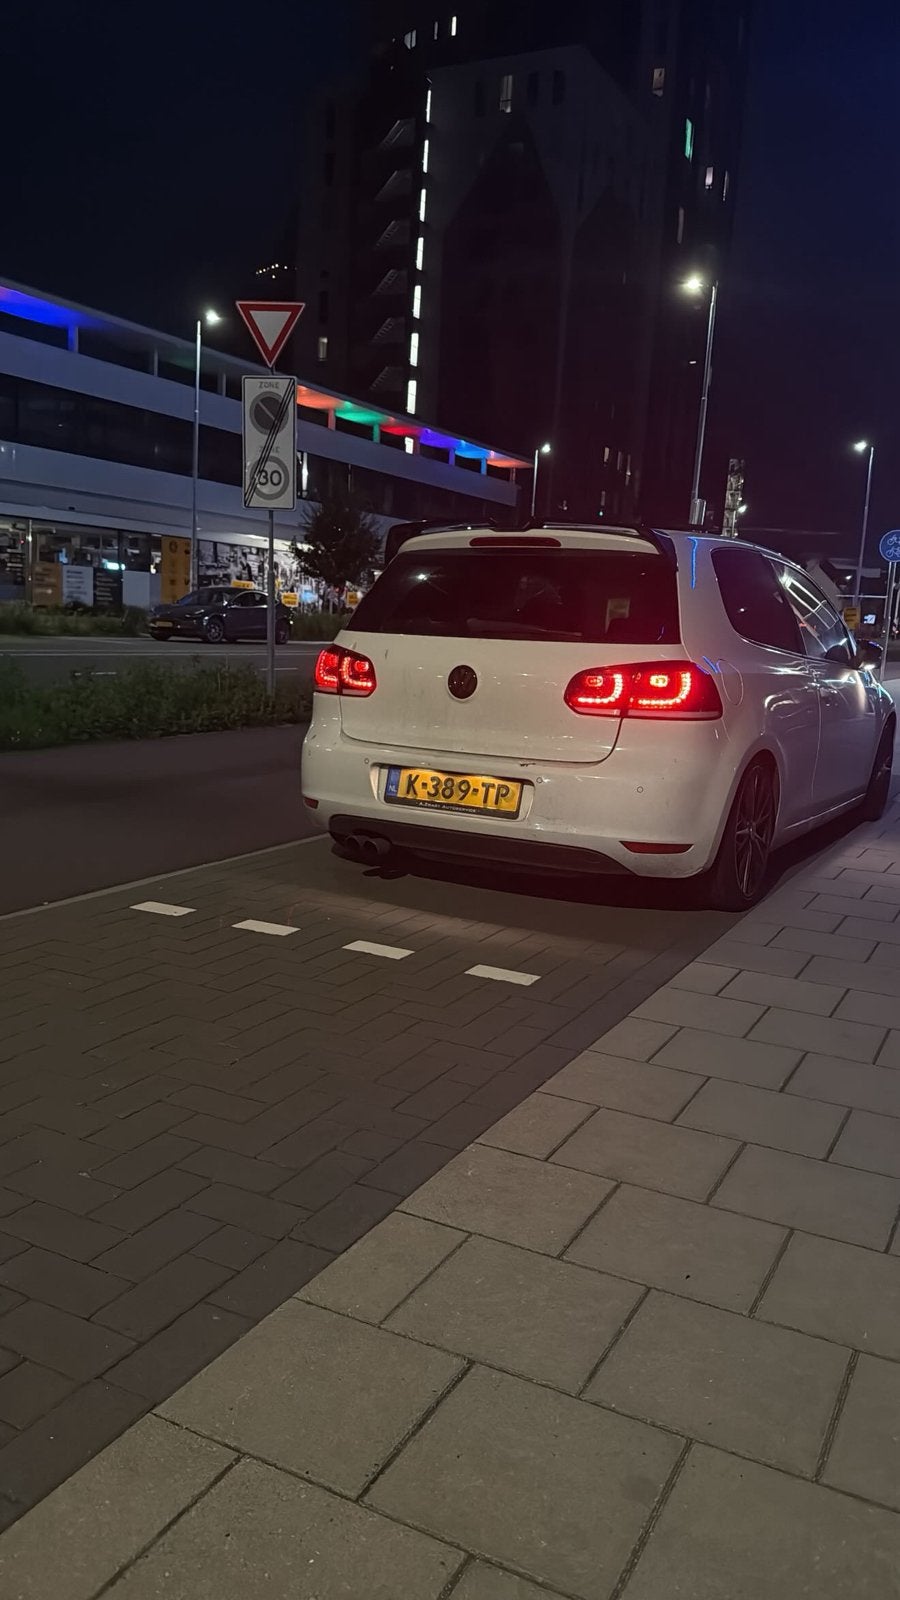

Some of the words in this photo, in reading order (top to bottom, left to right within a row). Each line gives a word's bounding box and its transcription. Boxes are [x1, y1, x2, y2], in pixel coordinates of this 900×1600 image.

[258, 381, 280, 389] ZONE
[258, 469, 282, 487] 30
[388, 785, 398, 793] NL
[405, 773, 511, 806] K-389-TP
